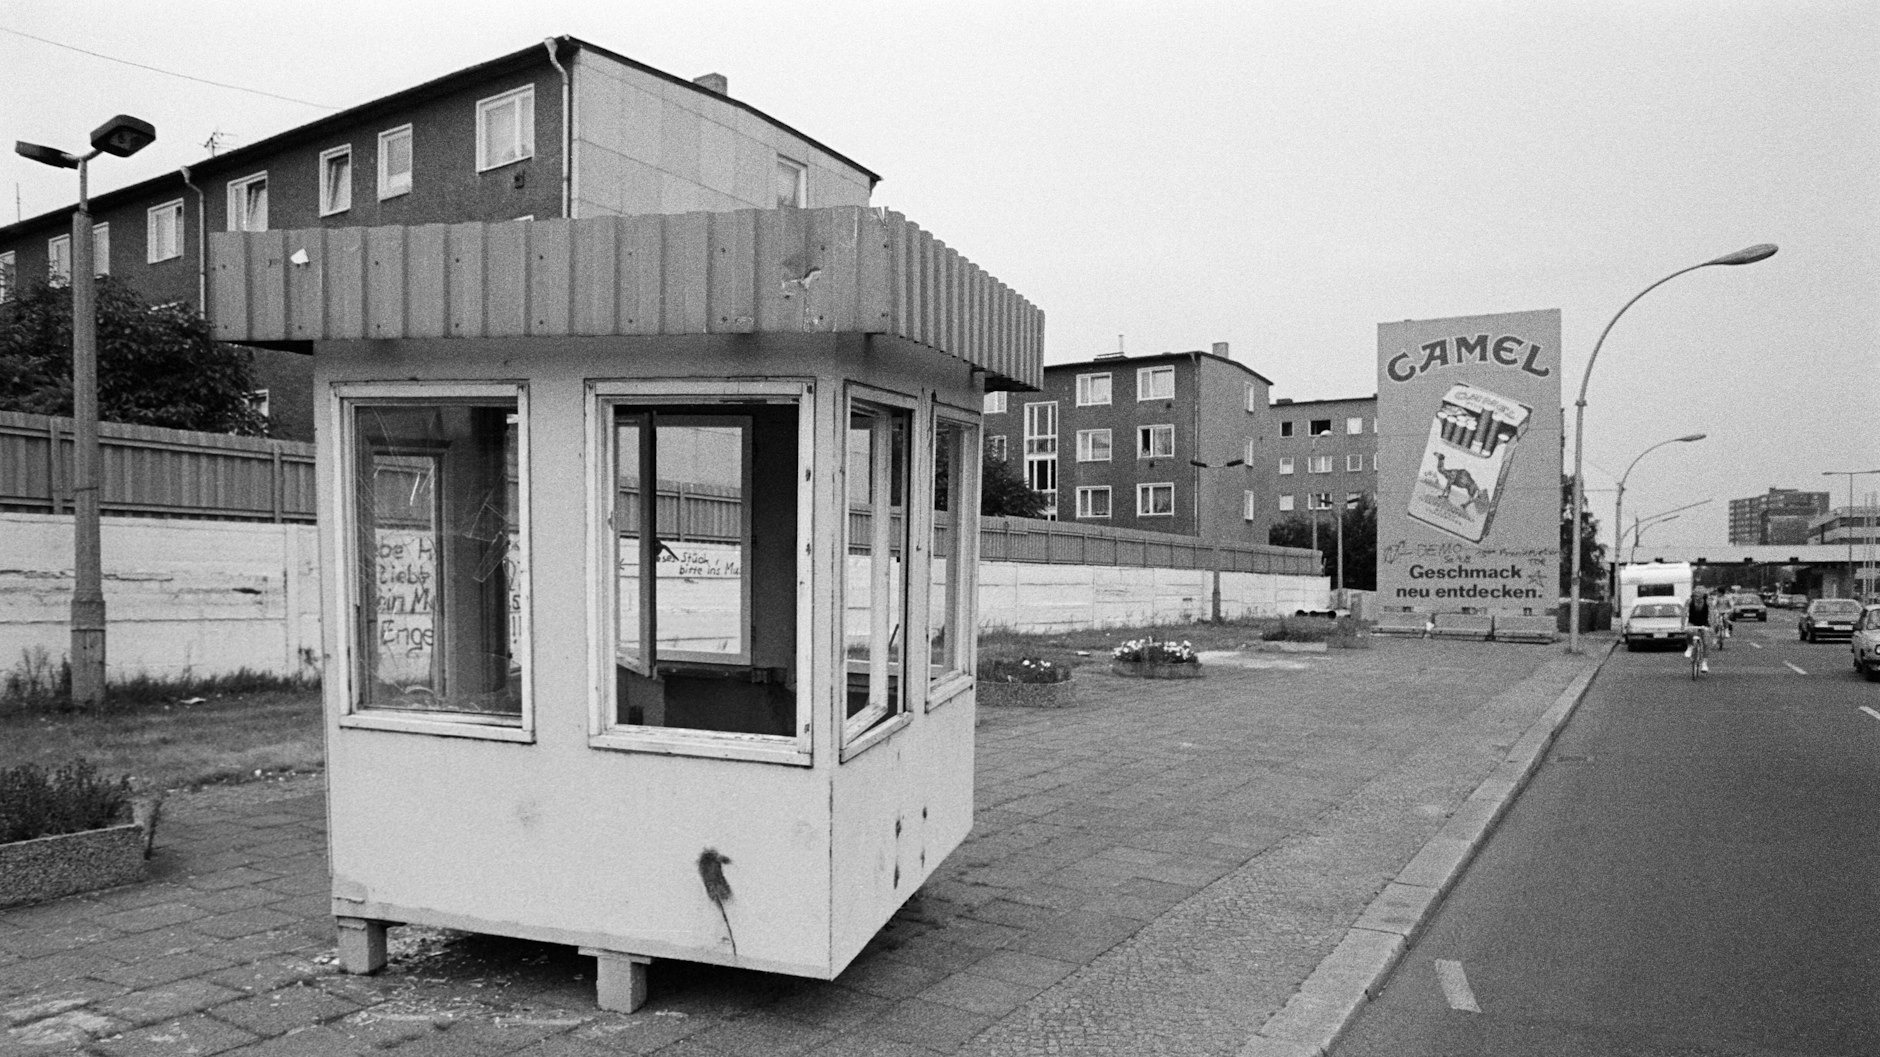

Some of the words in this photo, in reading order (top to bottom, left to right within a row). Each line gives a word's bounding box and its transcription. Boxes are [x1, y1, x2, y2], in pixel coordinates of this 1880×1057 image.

[1386, 333, 1551, 383] CAMEL
[680, 551, 710, 564] Stück
[679, 563, 703, 575] bitte
[707, 563, 721, 576] ins
[724, 561, 741, 576] Mu
[1409, 564, 1523, 580] Geschmack
[1396, 587, 1431, 599] neu
[1435, 584, 1544, 599] entdecken.
